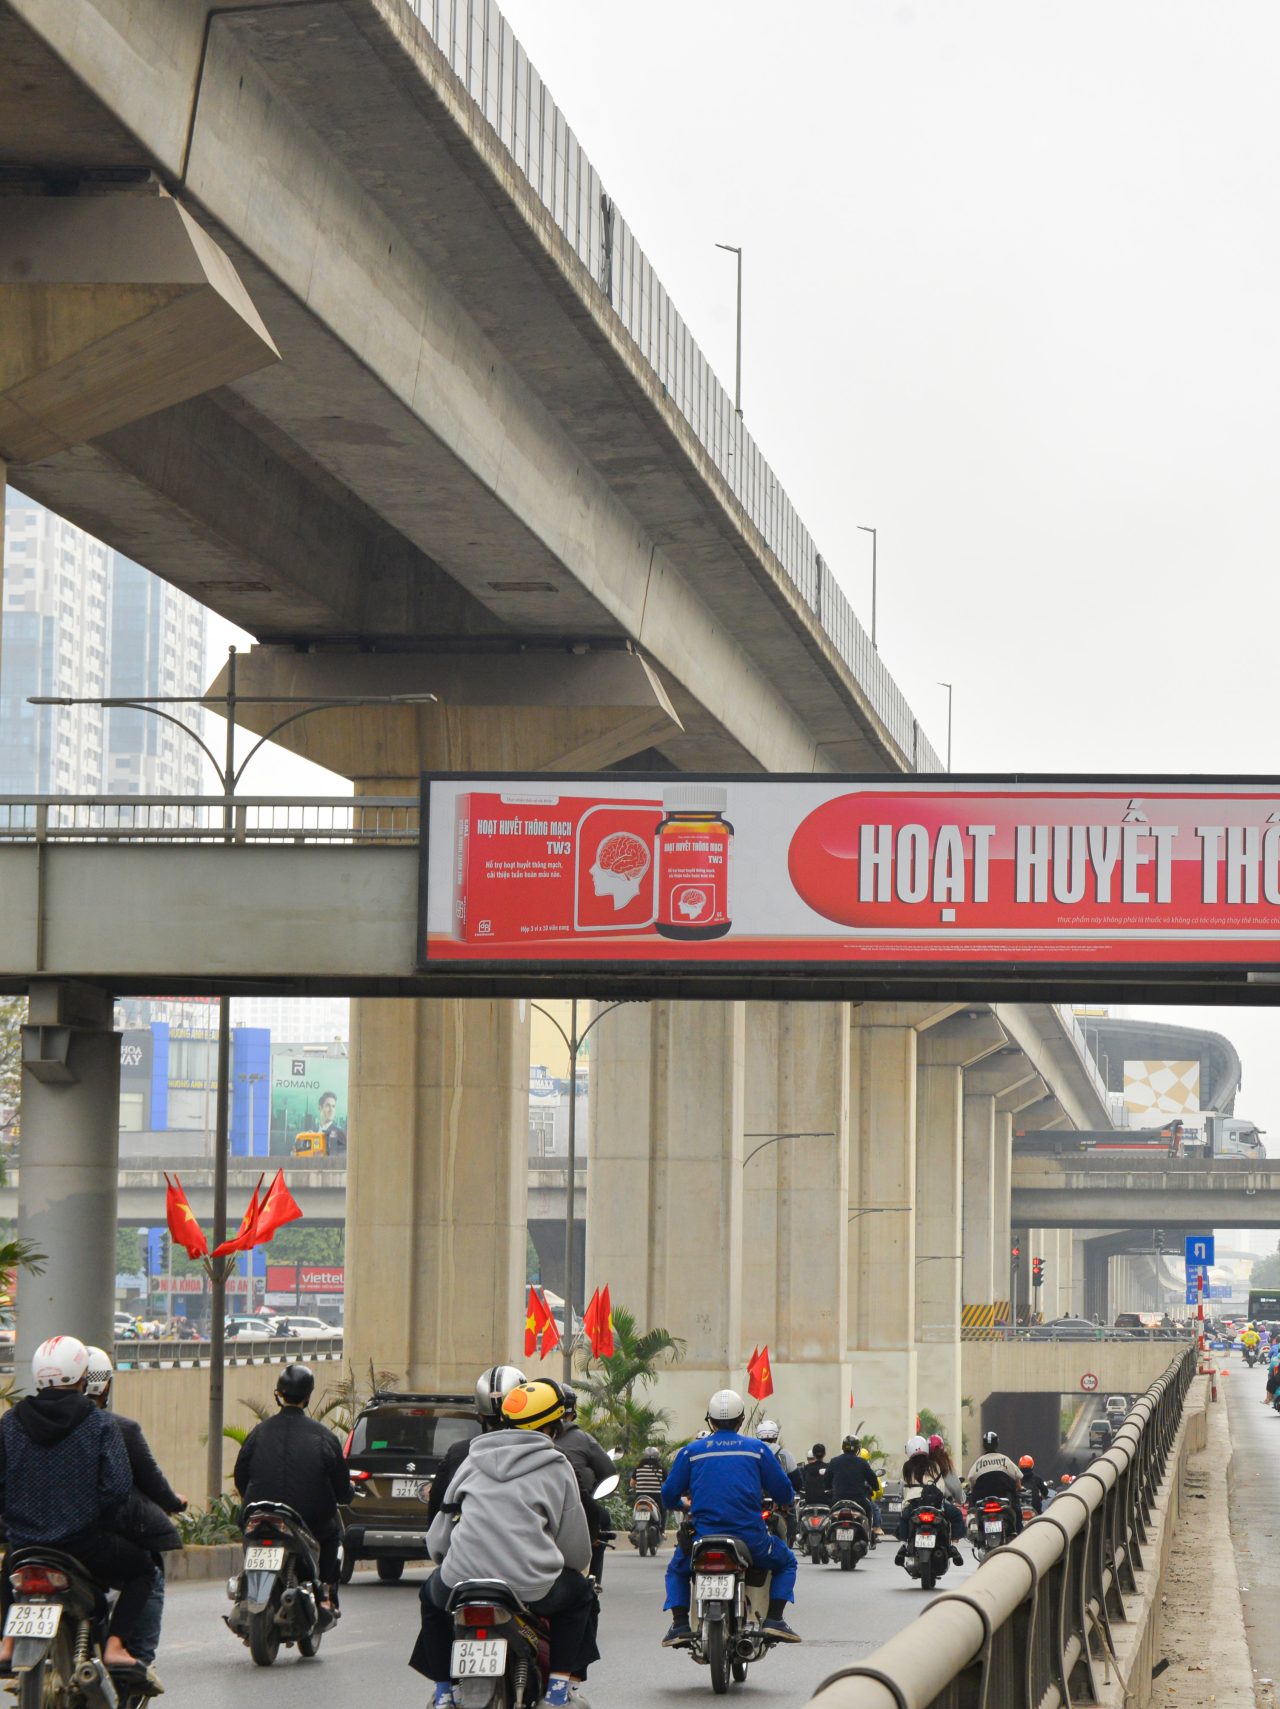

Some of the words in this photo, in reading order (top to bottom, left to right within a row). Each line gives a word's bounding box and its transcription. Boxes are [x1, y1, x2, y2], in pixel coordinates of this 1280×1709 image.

[477, 819, 497, 838] HOẠT
[500, 815, 522, 835] HUYẾT
[525, 818, 548, 836] THÔNG
[550, 821, 572, 839] MẠCH
[546, 841, 571, 855] TW3
[857, 823, 996, 922] HOẠT
[1014, 798, 1179, 904] HUYẾT
[121, 1046, 142, 1054] HOA
[276, 1080, 320, 1089] ROMANO
[700, 1587, 728, 1598] 7392
[15, 1606, 52, 1619] 29-X1
[8, 1621, 54, 1635] 720.93
[460, 1642, 498, 1657] 34-L4
[458, 1659, 497, 1674] 0248
